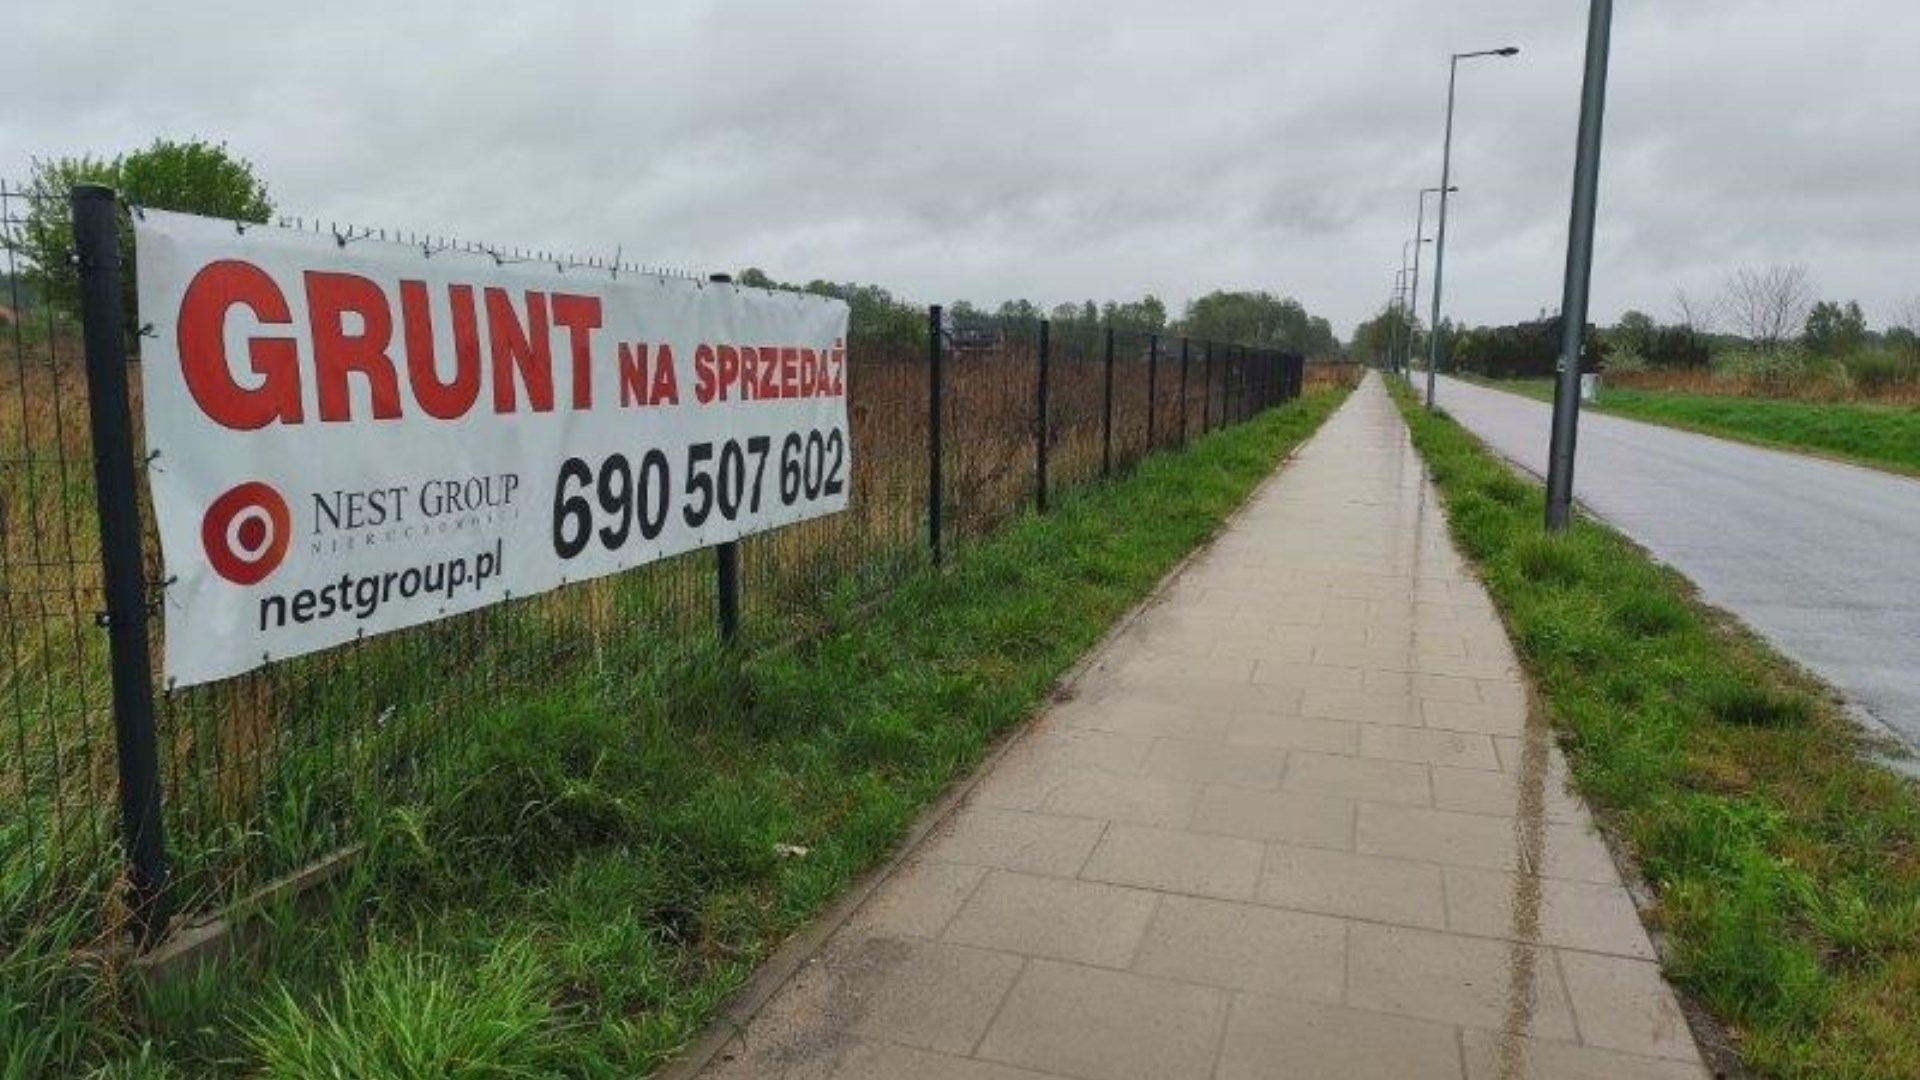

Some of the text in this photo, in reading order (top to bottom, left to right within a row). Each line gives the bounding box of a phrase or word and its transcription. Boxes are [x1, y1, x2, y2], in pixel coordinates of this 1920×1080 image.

[177, 259, 844, 431] GRUNT NA SPRZEDAŻ
[311, 486, 408, 535] NEST
[419, 474, 519, 518] GROUP
[553, 448, 671, 559] 690
[682, 435, 771, 528] 507
[780, 427, 844, 506] 602
[260, 537, 502, 631] nestgroup.pl
